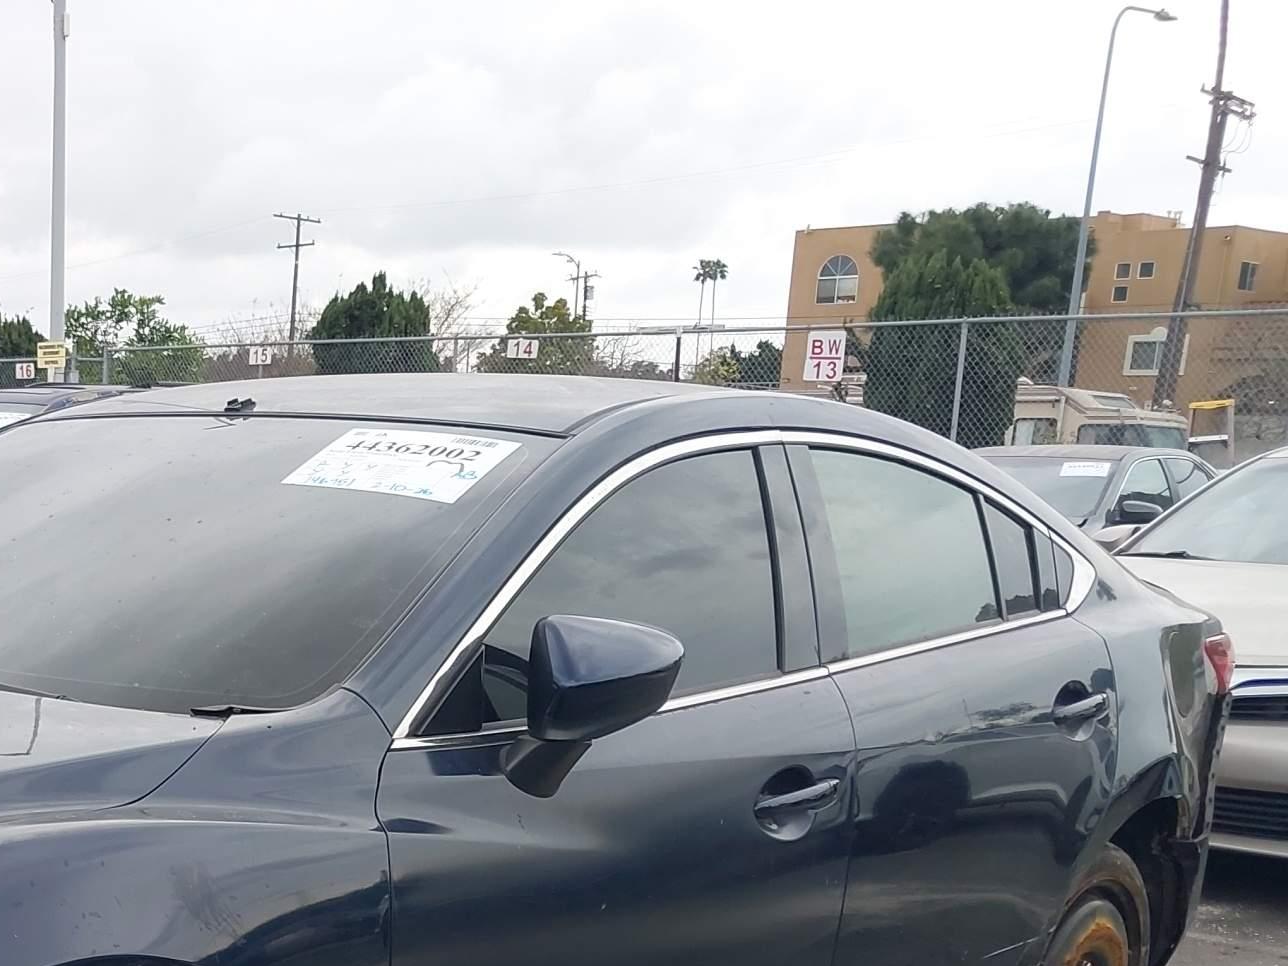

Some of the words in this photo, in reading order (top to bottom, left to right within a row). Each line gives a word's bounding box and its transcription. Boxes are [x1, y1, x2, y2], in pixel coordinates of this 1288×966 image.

[253, 348, 268, 364] 15
[513, 340, 533, 357] 14
[19, 364, 32, 378] 16
[812, 361, 837, 380] 13
[345, 440, 482, 462] 44362002
